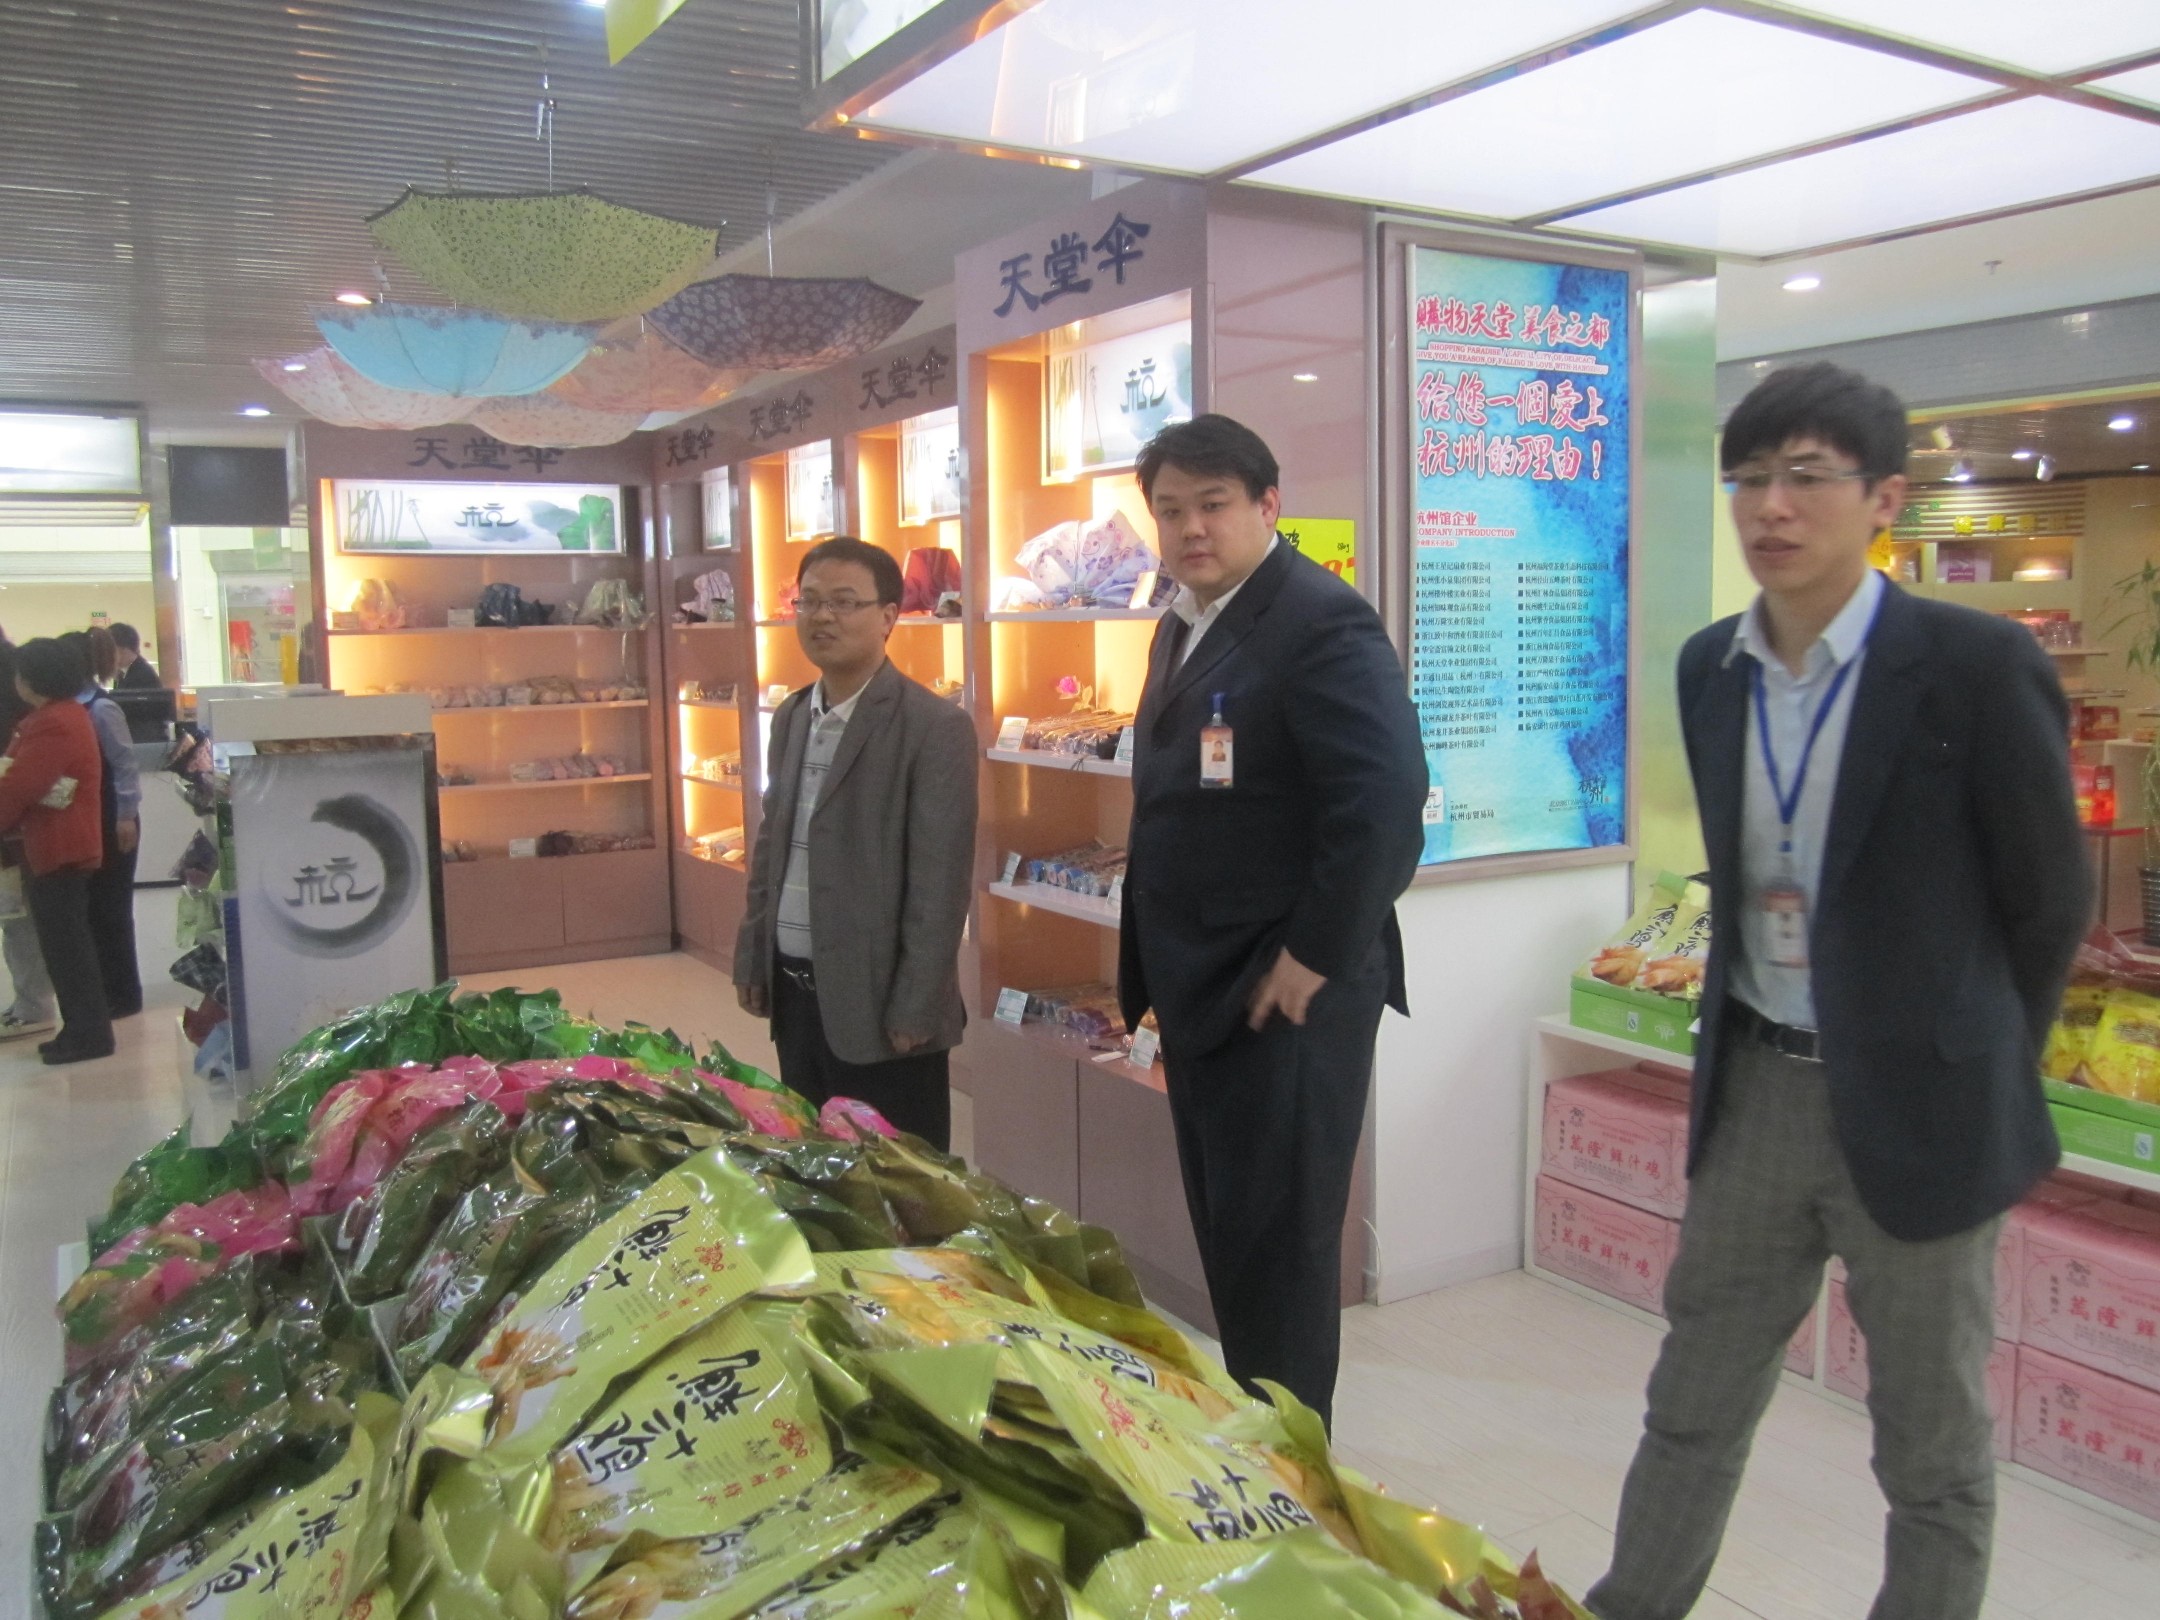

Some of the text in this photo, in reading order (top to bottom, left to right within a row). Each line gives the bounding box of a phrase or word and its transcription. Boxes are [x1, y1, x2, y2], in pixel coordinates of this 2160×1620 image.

[993, 211, 1150, 317] 天堂伞
[1518, 305, 1610, 349] 美食之都
[1429, 342, 1466, 353] SHOPPING
[1466, 347, 1502, 357] PARADISE
[1434, 352, 1449, 361] YOU
[1457, 354, 1486, 364] REASON
[1487, 356, 1497, 365] OF
[1498, 357, 1527, 367] FALLING
[1535, 360, 1554, 370] LOVE
[1554, 362, 1572, 371] WITH
[858, 346, 949, 411] 天堂伞
[749, 389, 814, 442] 天堂伞
[666, 423, 715, 467] 天堂伞
[1418, 528, 1515, 538] OMPANY INTRODUCTION
